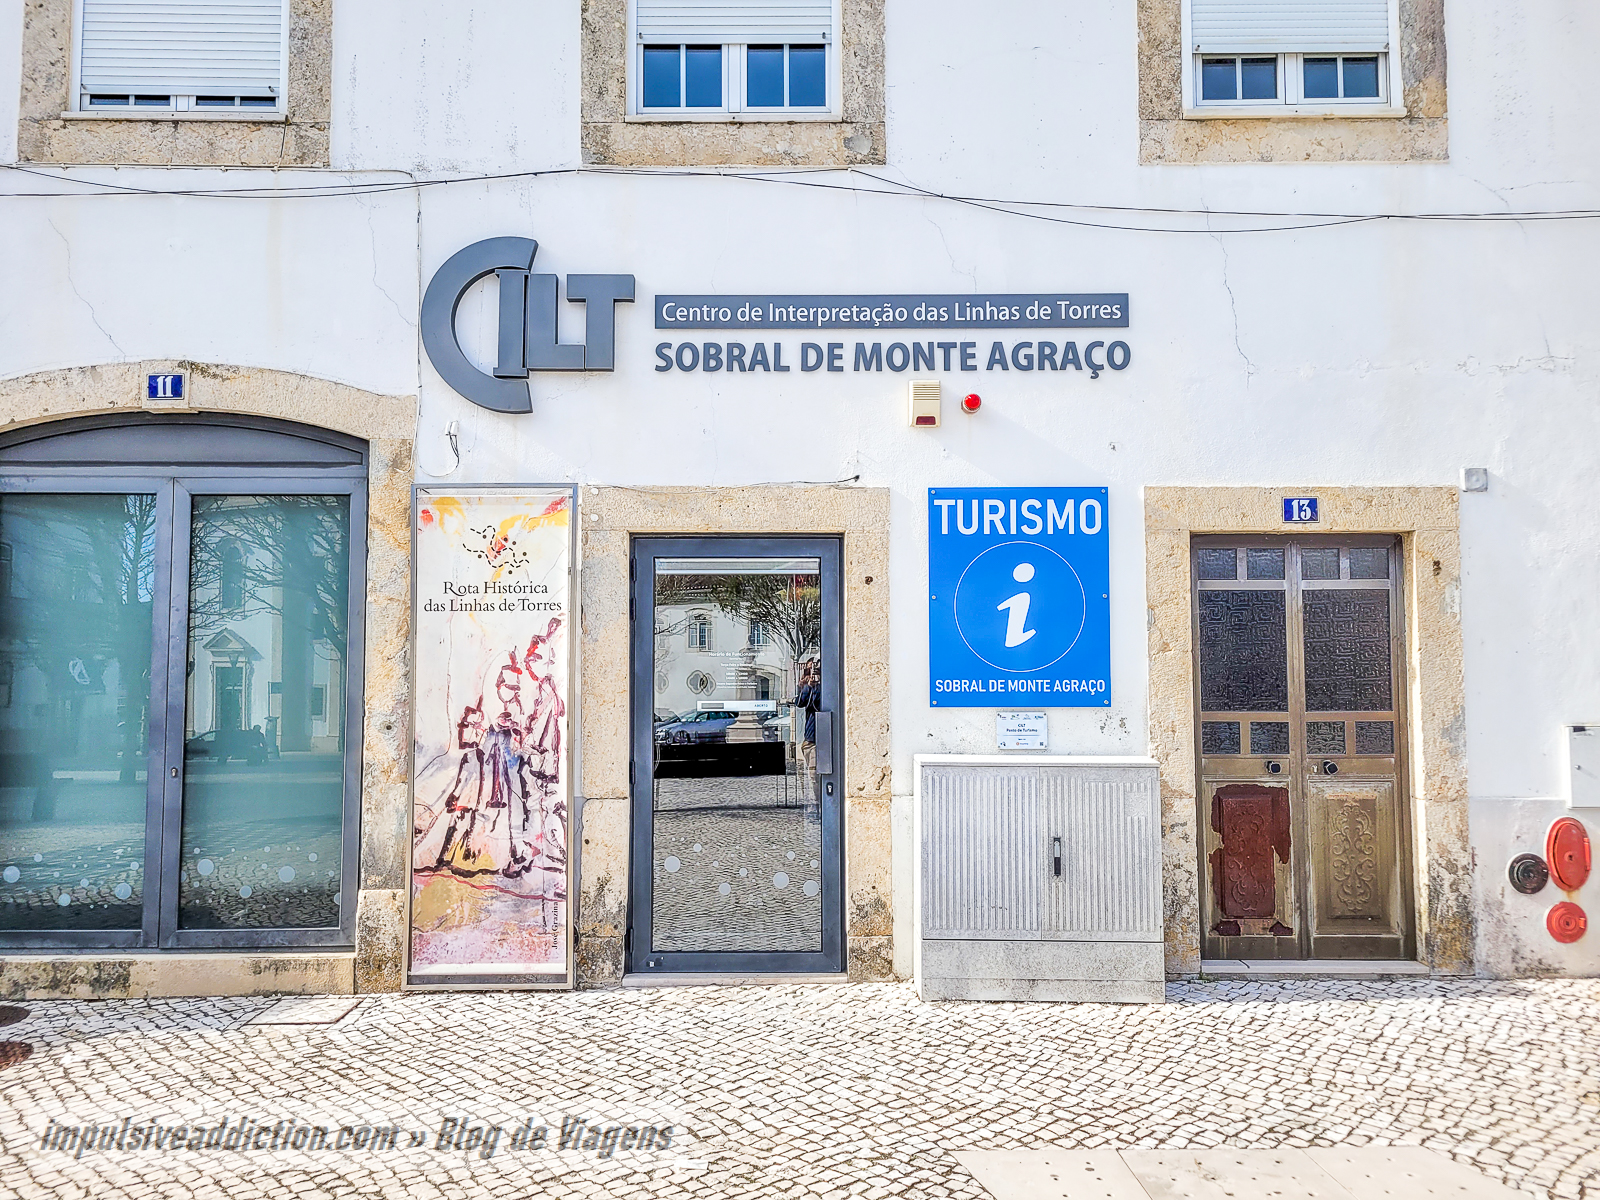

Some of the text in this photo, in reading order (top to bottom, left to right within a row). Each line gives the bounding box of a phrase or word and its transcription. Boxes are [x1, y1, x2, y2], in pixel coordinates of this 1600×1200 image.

[662, 301, 1122, 327] Centro de Interpretação das Linhas de Torres
[421, 236, 635, 414] CILT
[655, 340, 1131, 379] SOBRAL DE MONTE AGRAÇO
[157, 376, 173, 397] 11
[934, 499, 1101, 535] TURISMO
[1292, 500, 1311, 520] 13
[443, 580, 549, 596] Rota Histórica
[424, 598, 562, 611] das Linhas de Torres
[935, 679, 1106, 695] SOBRAL DE MONTE AGRAÇO
